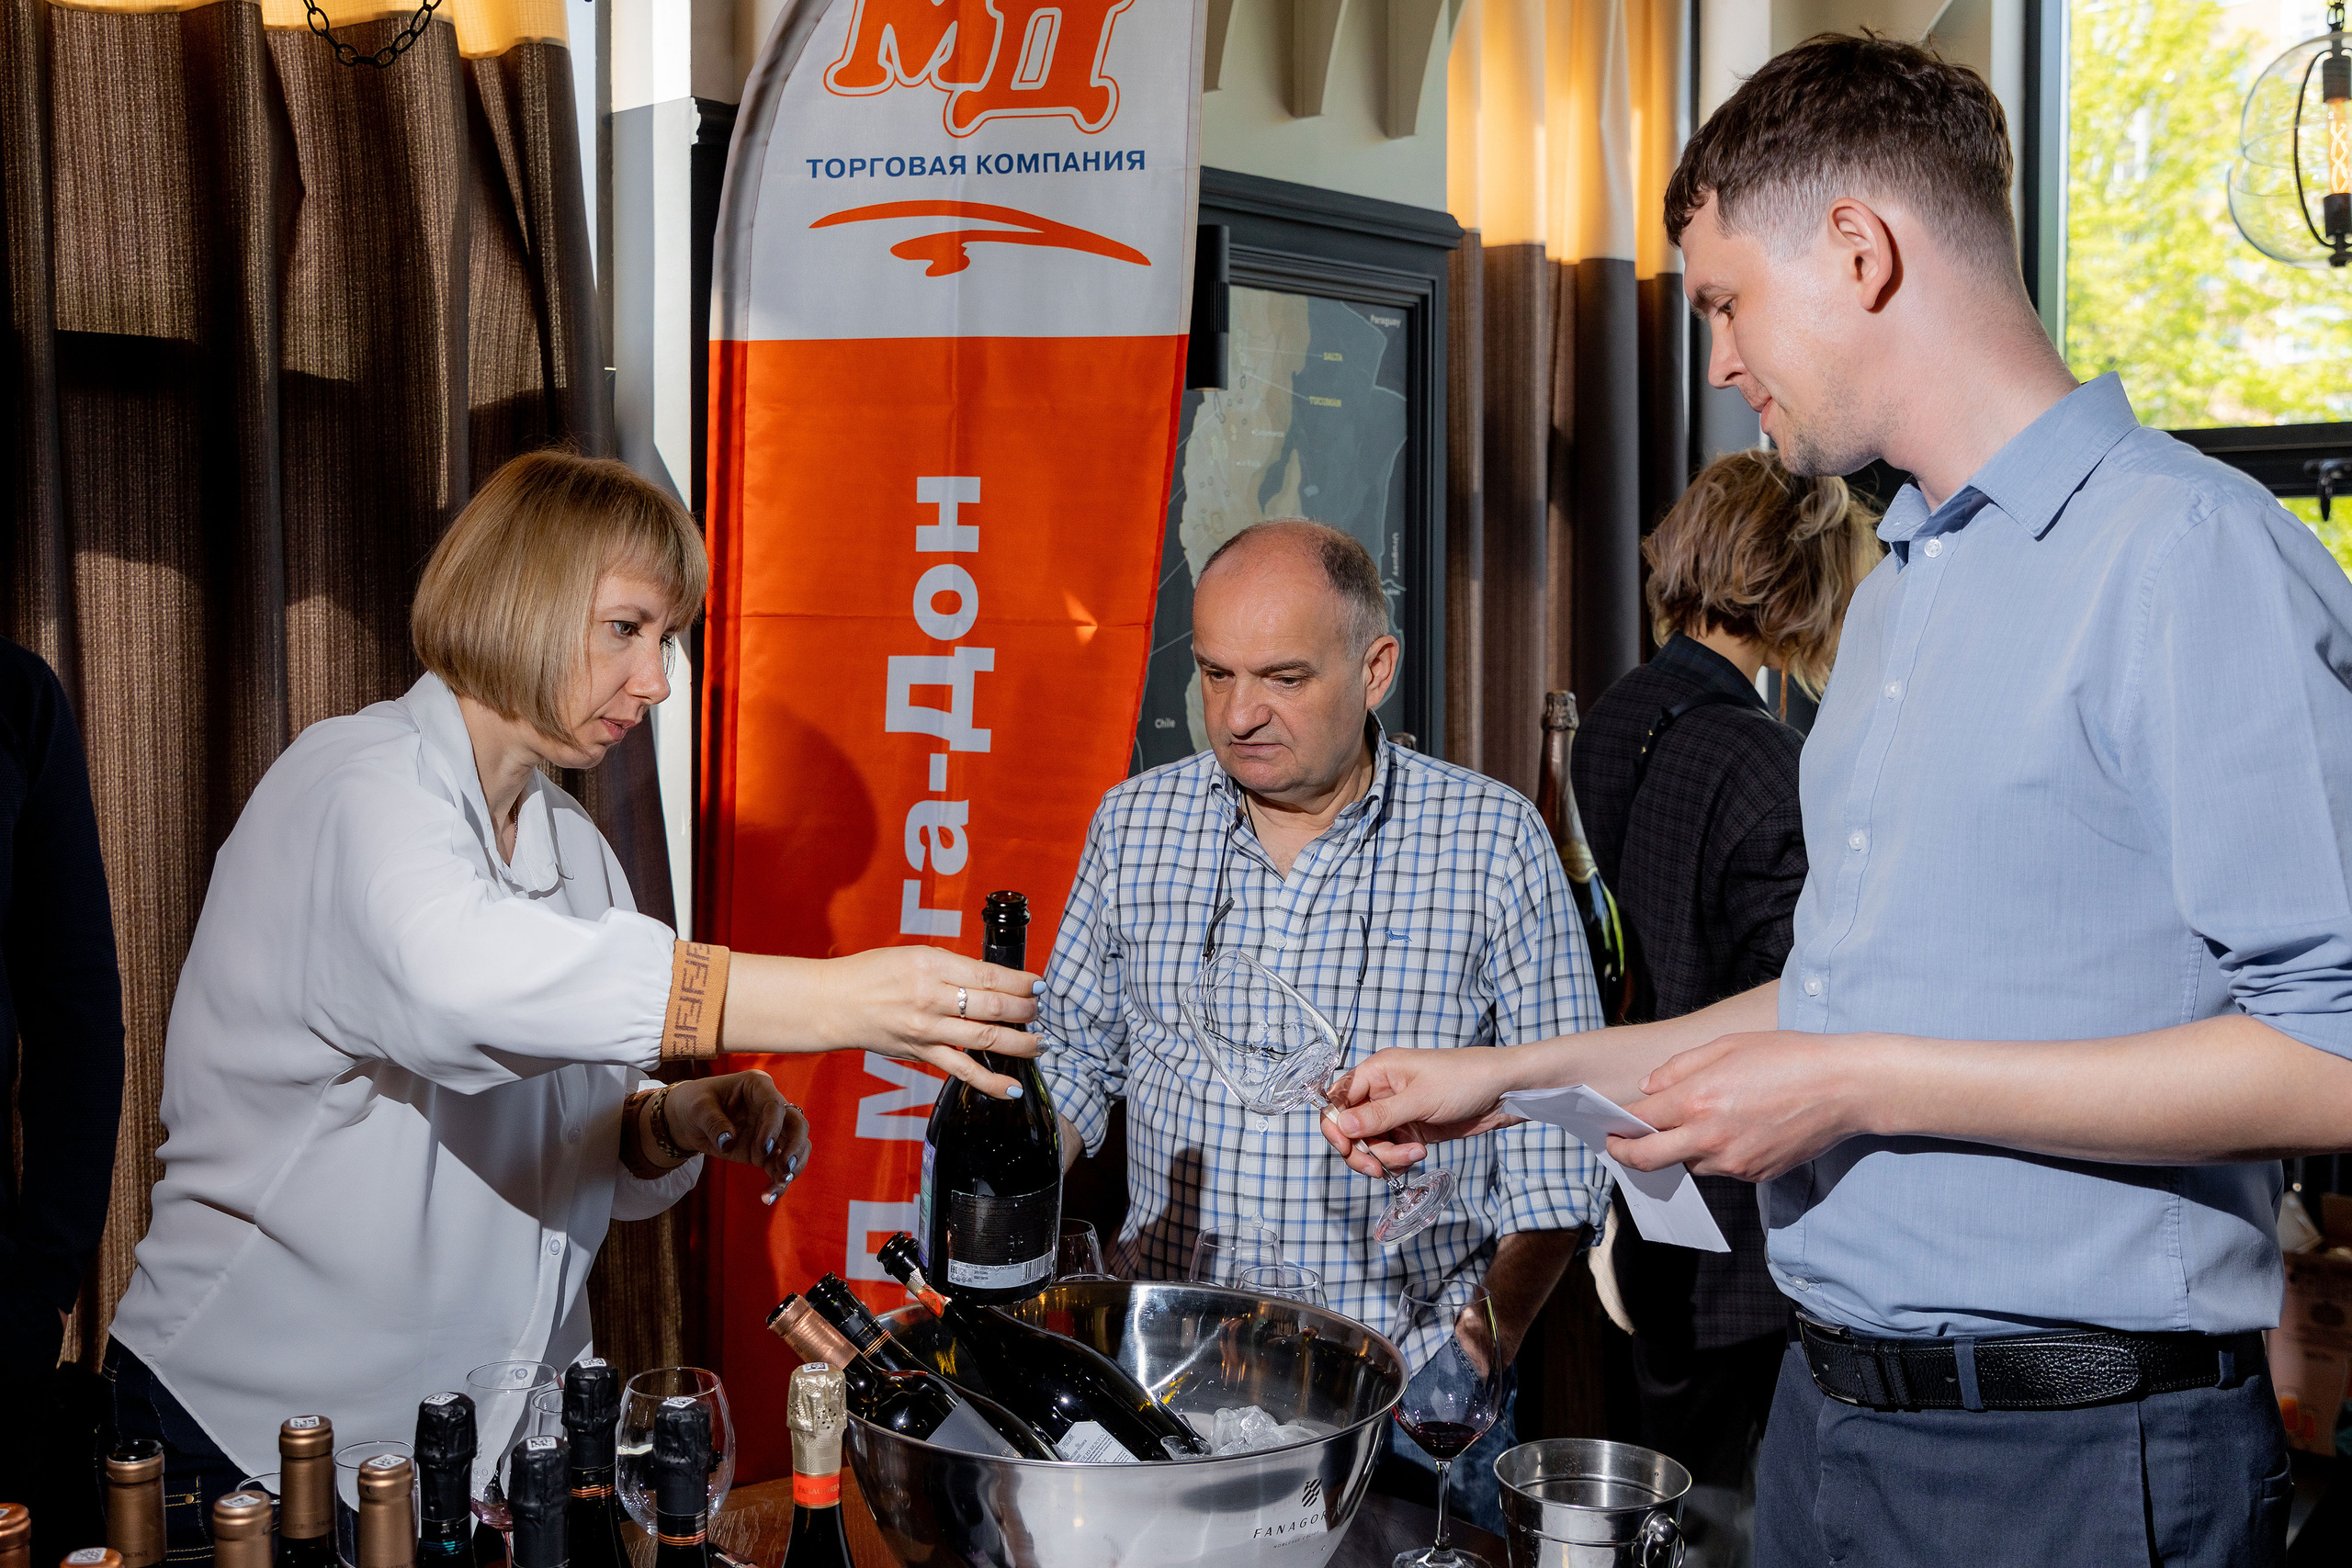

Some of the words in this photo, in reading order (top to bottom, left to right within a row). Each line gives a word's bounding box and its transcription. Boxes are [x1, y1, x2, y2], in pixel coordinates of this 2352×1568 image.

[806, 155, 966, 179] ТОРГОВАЯ
[977, 150, 1146, 175] КОМПАНИЯ
[1154, 717, 1176, 728] Chile
[854, 475, 996, 1142] Мга-Дон
